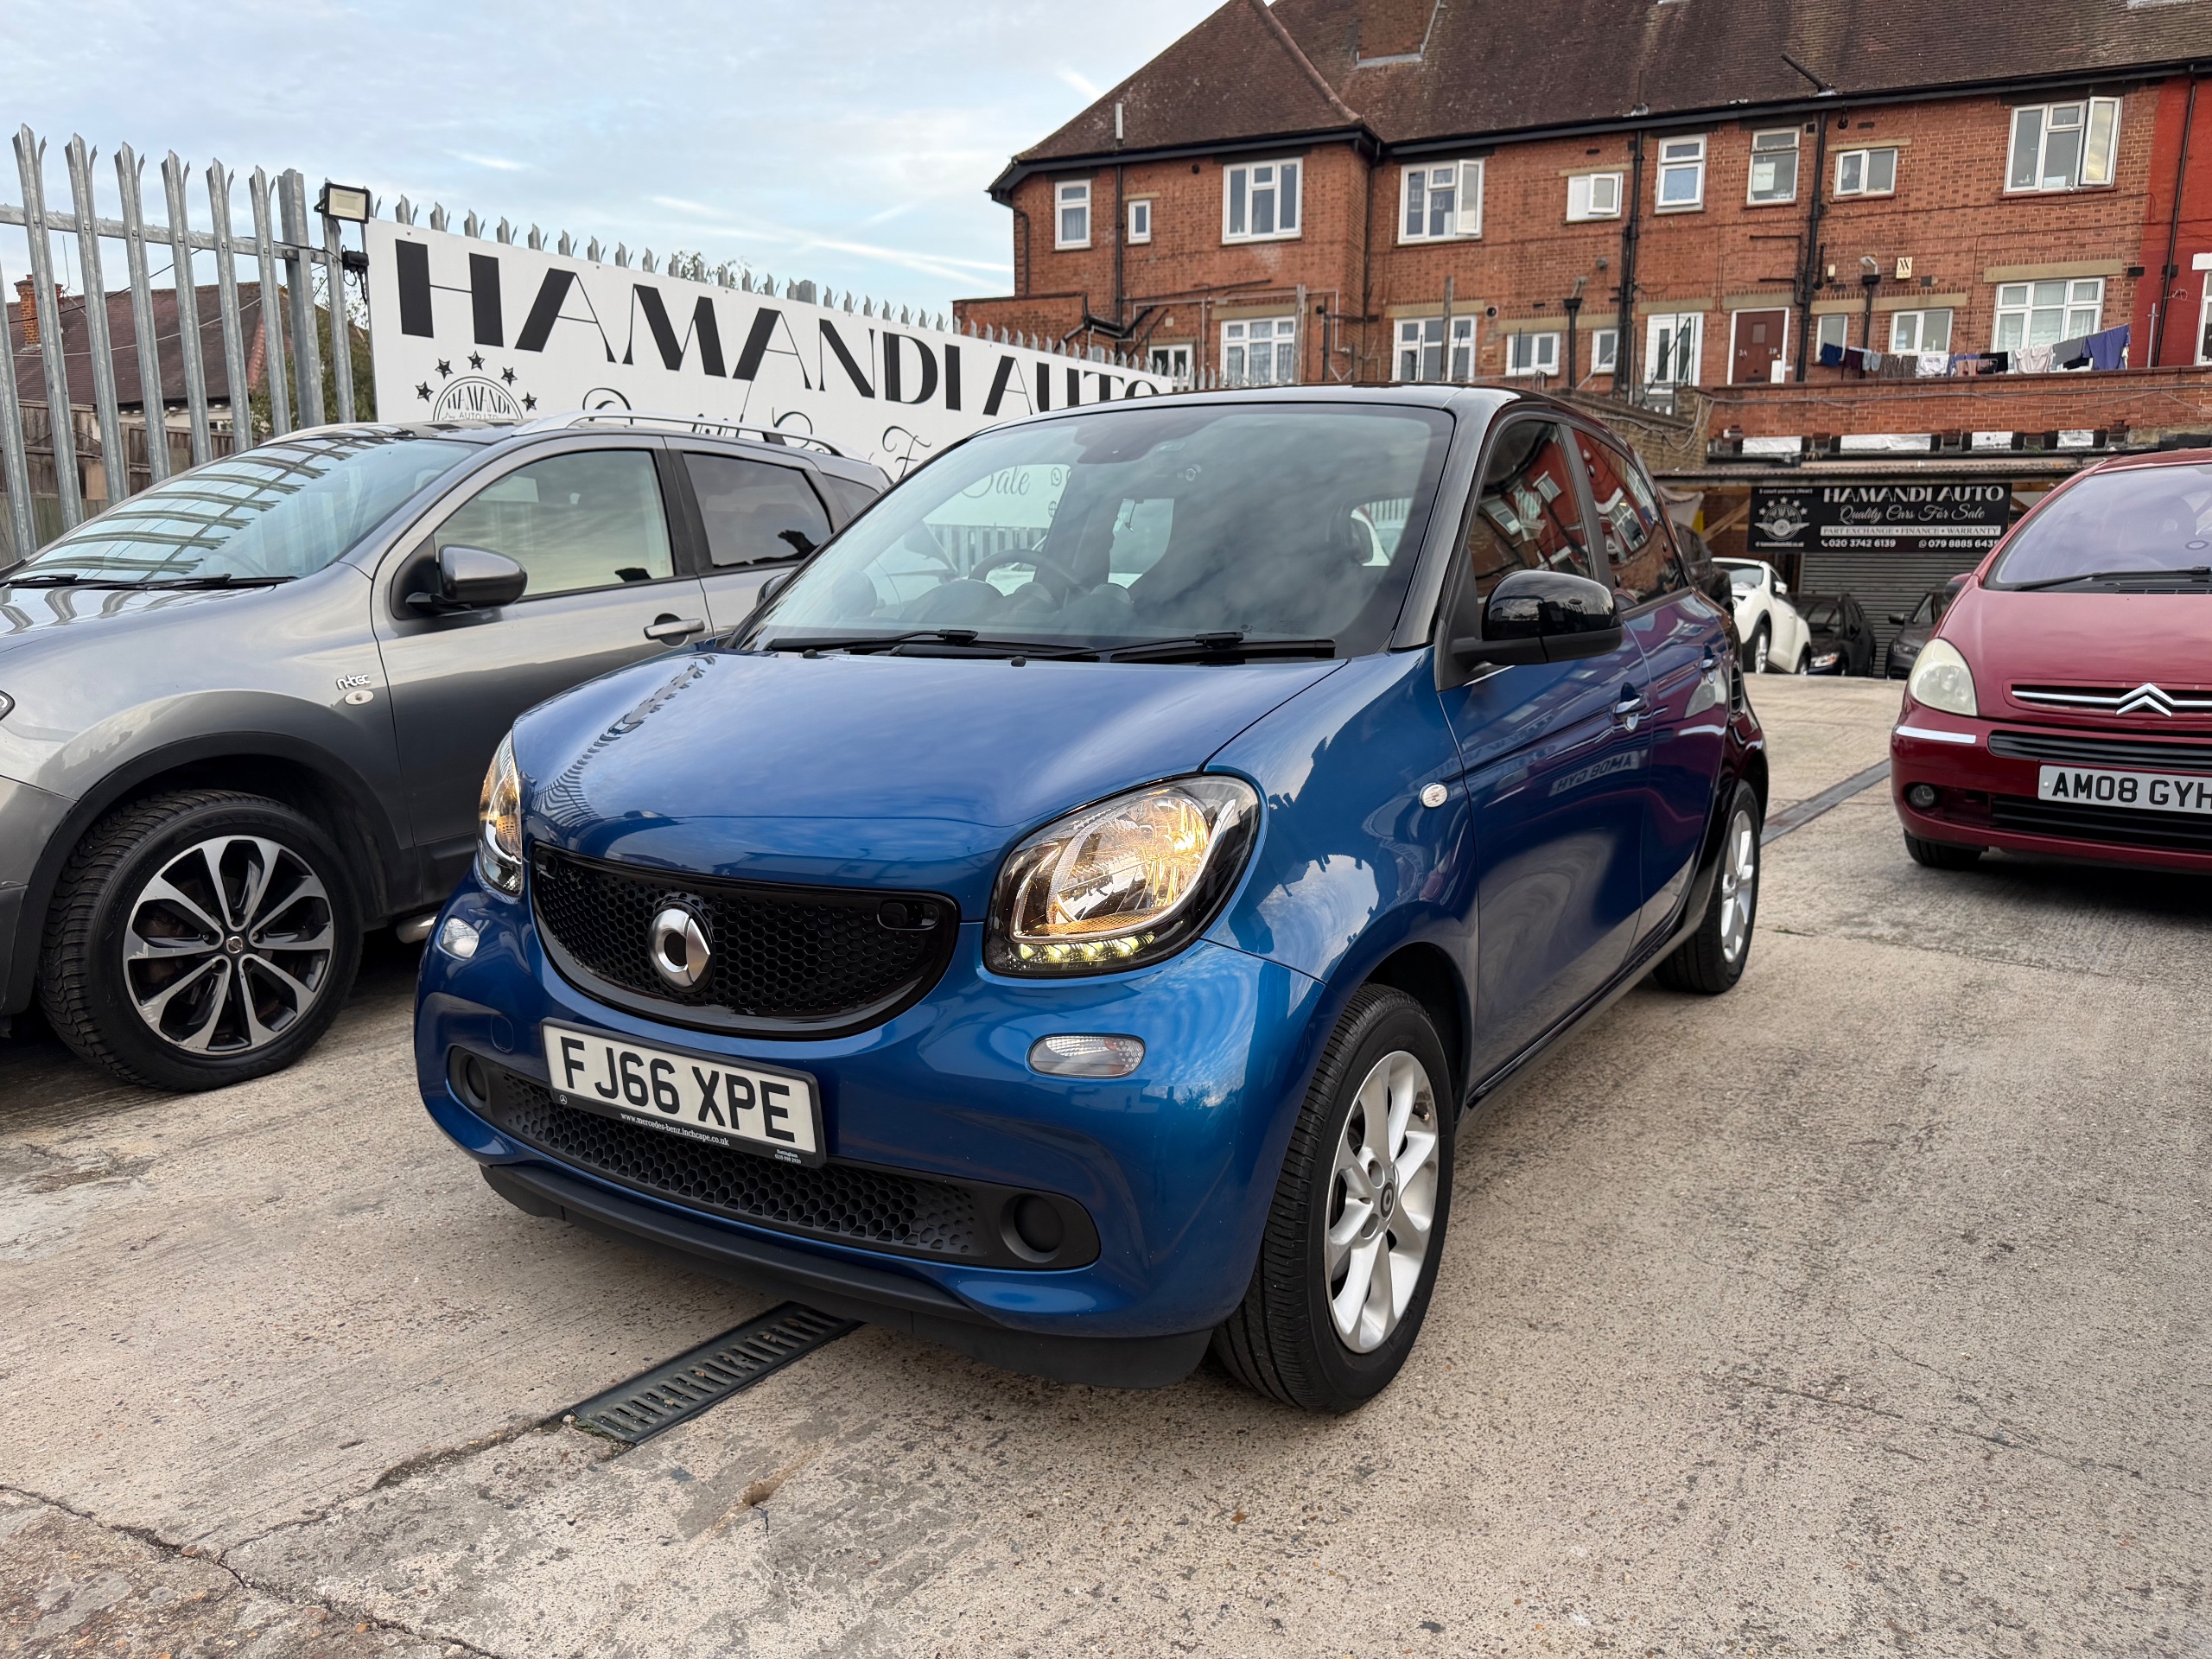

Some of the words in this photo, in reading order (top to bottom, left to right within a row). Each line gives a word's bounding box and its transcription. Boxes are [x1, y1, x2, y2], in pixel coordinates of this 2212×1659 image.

[396, 239, 962, 411] HAMANDI
[982, 355, 1160, 416] AUT
[447, 385, 511, 415] HAMANDI
[1823, 486, 1933, 503] HAMANDI
[1936, 486, 2005, 502] AUTO
[1839, 505, 1883, 524] Quality
[1885, 504, 1915, 520] Cars
[1918, 505, 1949, 521] For
[1951, 504, 1986, 520] Sale
[1928, 539, 1947, 548] 079
[2051, 772, 2139, 803] AM08
[2149, 779, 2212, 809] GYH
[560, 1036, 681, 1115] FJ66
[691, 1066, 795, 1142] XPE
[620, 1112, 730, 1147] www.mercedes-benz.inchcape.co.uk
